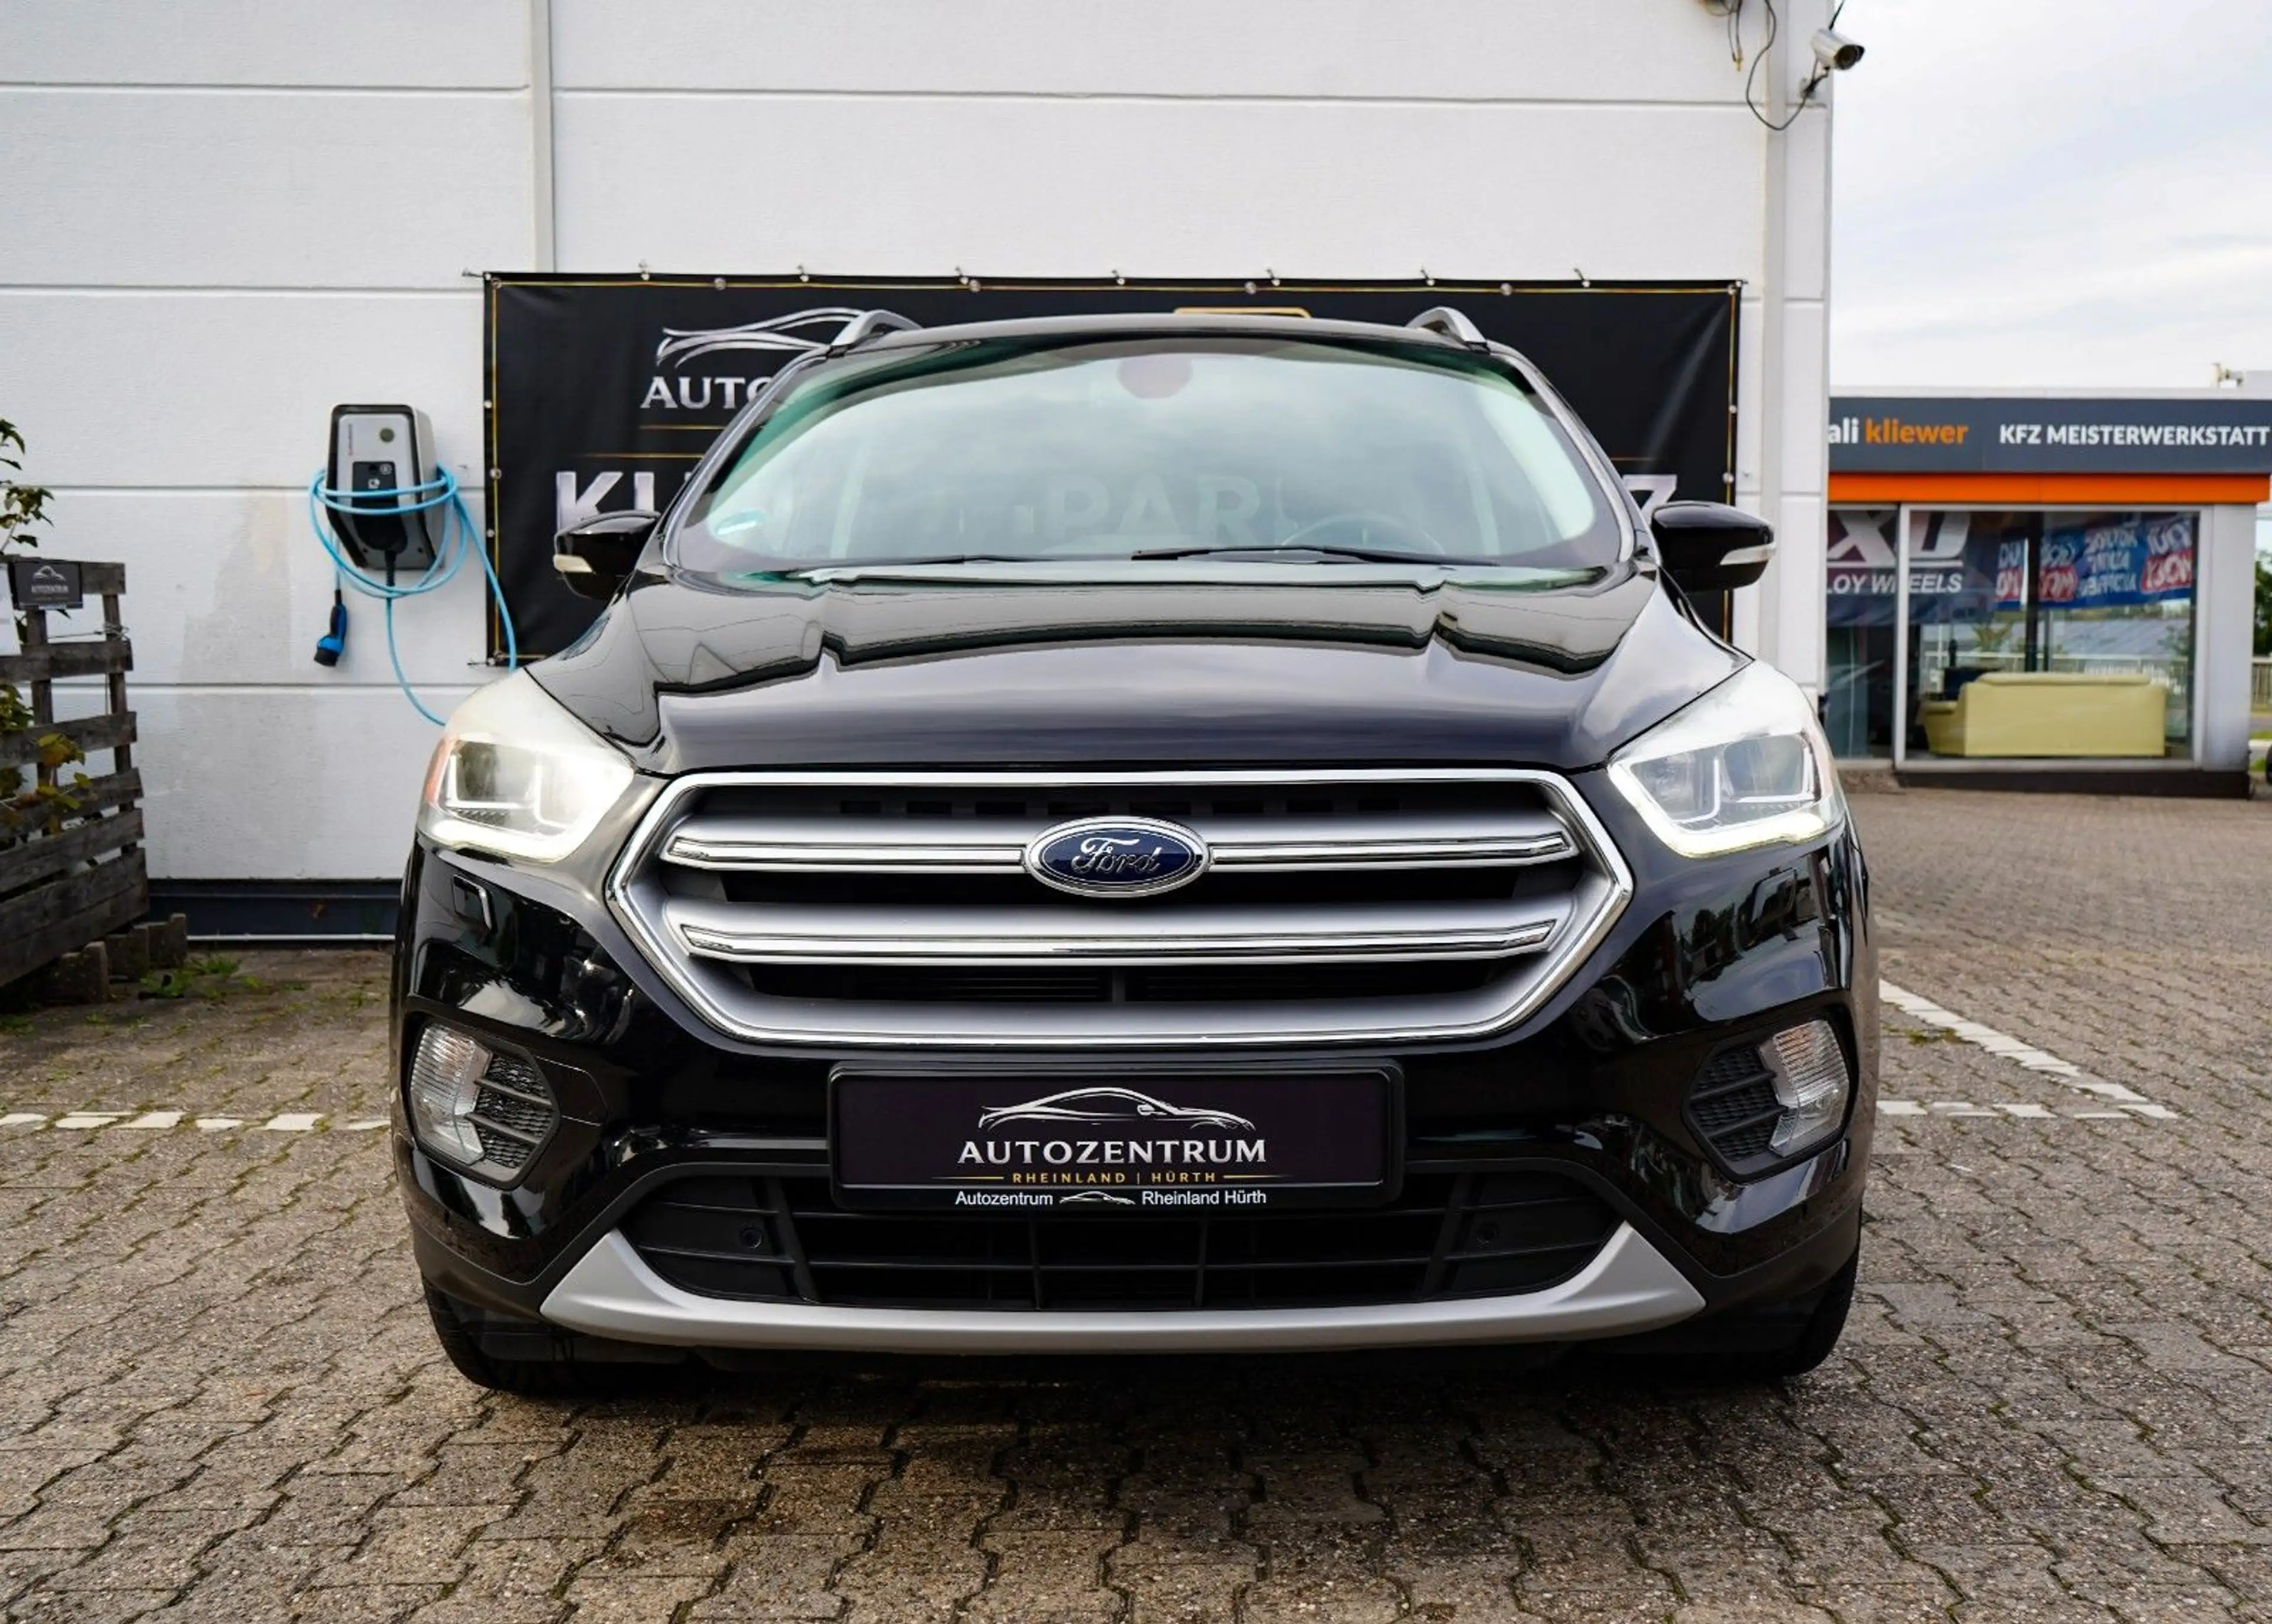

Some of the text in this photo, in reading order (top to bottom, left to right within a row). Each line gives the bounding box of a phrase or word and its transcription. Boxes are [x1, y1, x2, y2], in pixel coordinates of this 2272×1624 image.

[1865, 418, 1969, 444] kliewer
[1999, 424, 2271, 445] KFZ MEISTERWERKSTATT
[1071, 837, 1162, 874] Ford
[957, 1139, 1267, 1164] AUTOZENTRUM
[1012, 1173, 1126, 1183] RHEINLAND
[1151, 1170, 1216, 1183] HÜRTH
[955, 1189, 1267, 1205] Autozentrum Rheinland Hürth
